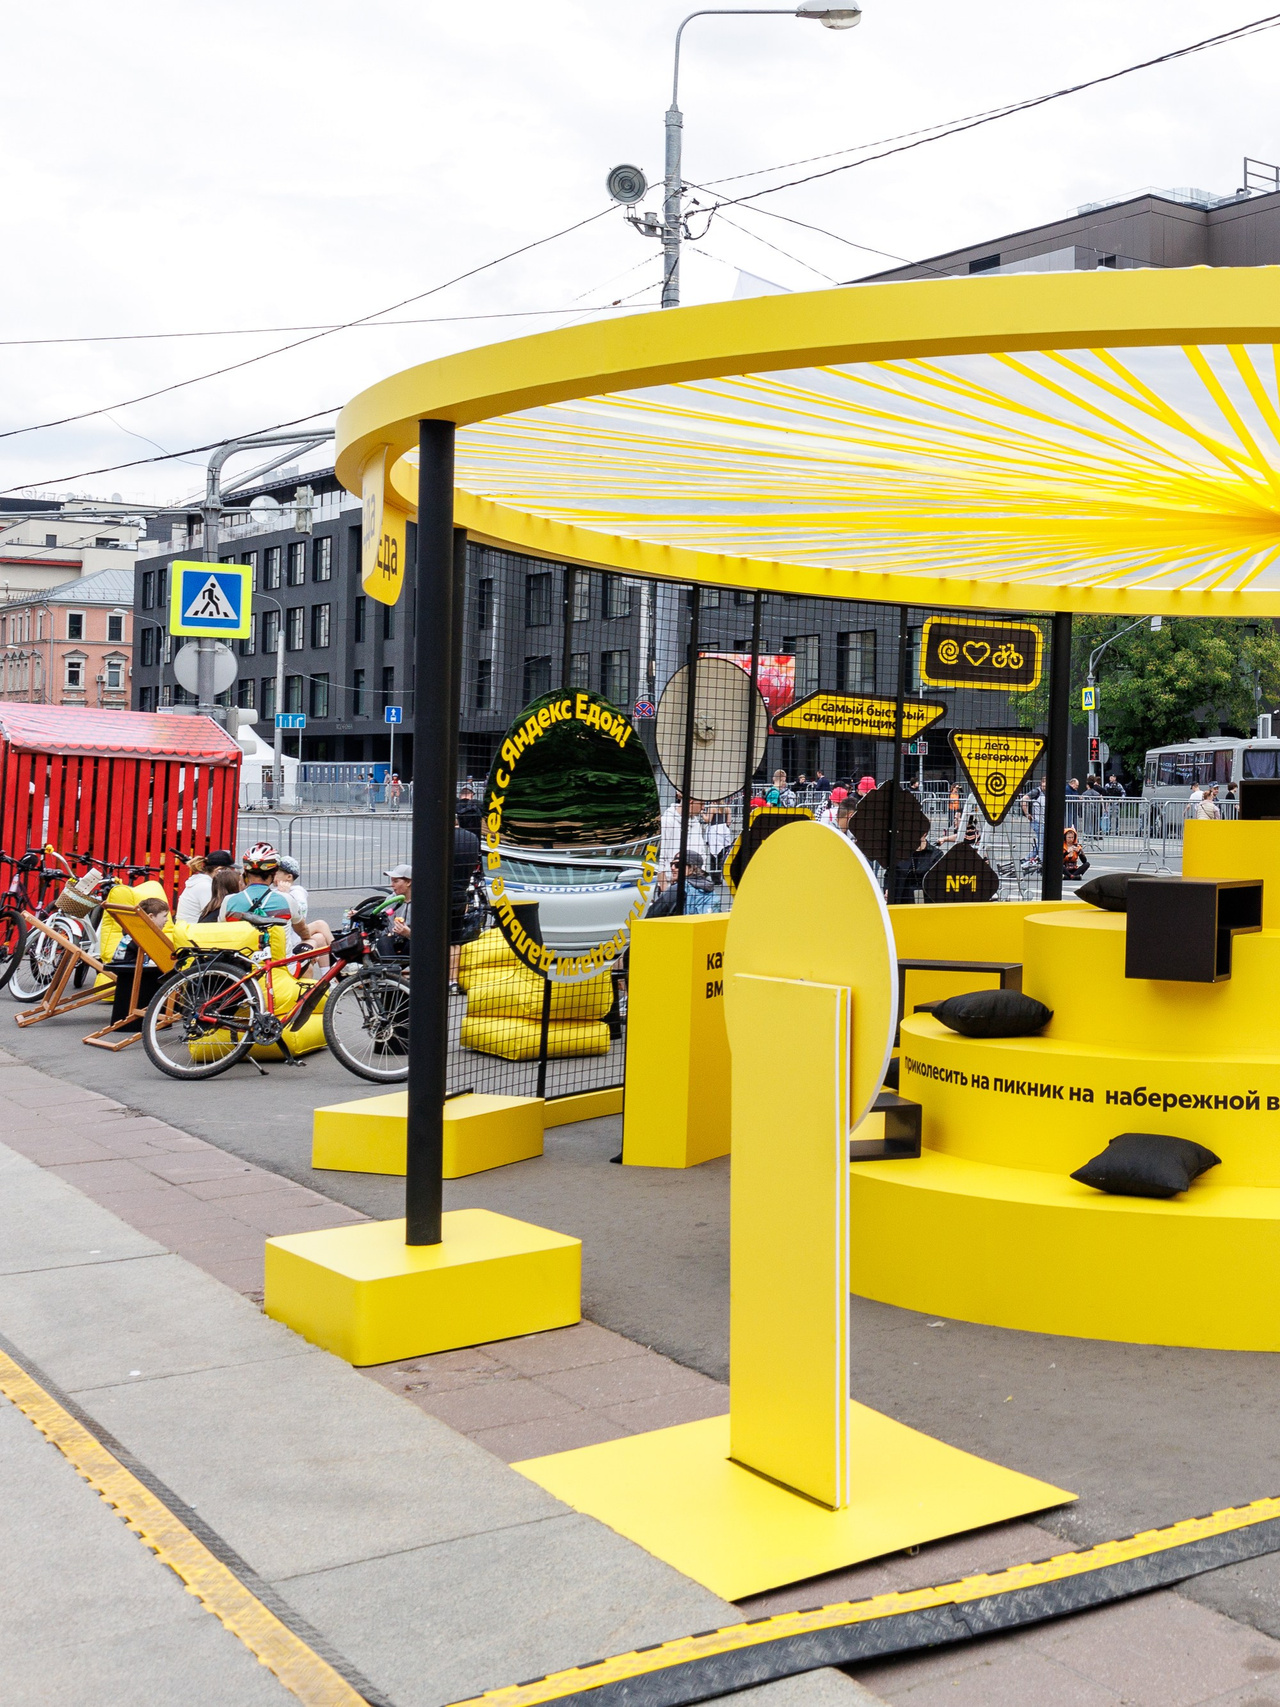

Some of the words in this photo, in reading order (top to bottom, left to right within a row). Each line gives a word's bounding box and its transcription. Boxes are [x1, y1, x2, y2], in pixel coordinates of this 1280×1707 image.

[575, 693, 633, 749] Едой!
[821, 702, 864, 716] самый
[501, 699, 572, 772] Яндекс
[966, 752, 973, 760] с
[974, 753, 1029, 764] ветерком
[984, 742, 1010, 751] лето
[496, 768, 511, 789] с
[486, 791, 506, 871] всех
[495, 876, 557, 972] дальше
[556, 927, 627, 976] педали
[706, 951, 725, 971] ка
[904, 1055, 969, 1086] приколесить
[971, 1073, 990, 1091] на
[993, 1077, 1065, 1100] пикник
[1068, 1086, 1095, 1104] на
[1105, 1086, 1261, 1113] набережной
[1266, 1096, 1280, 1110] в
